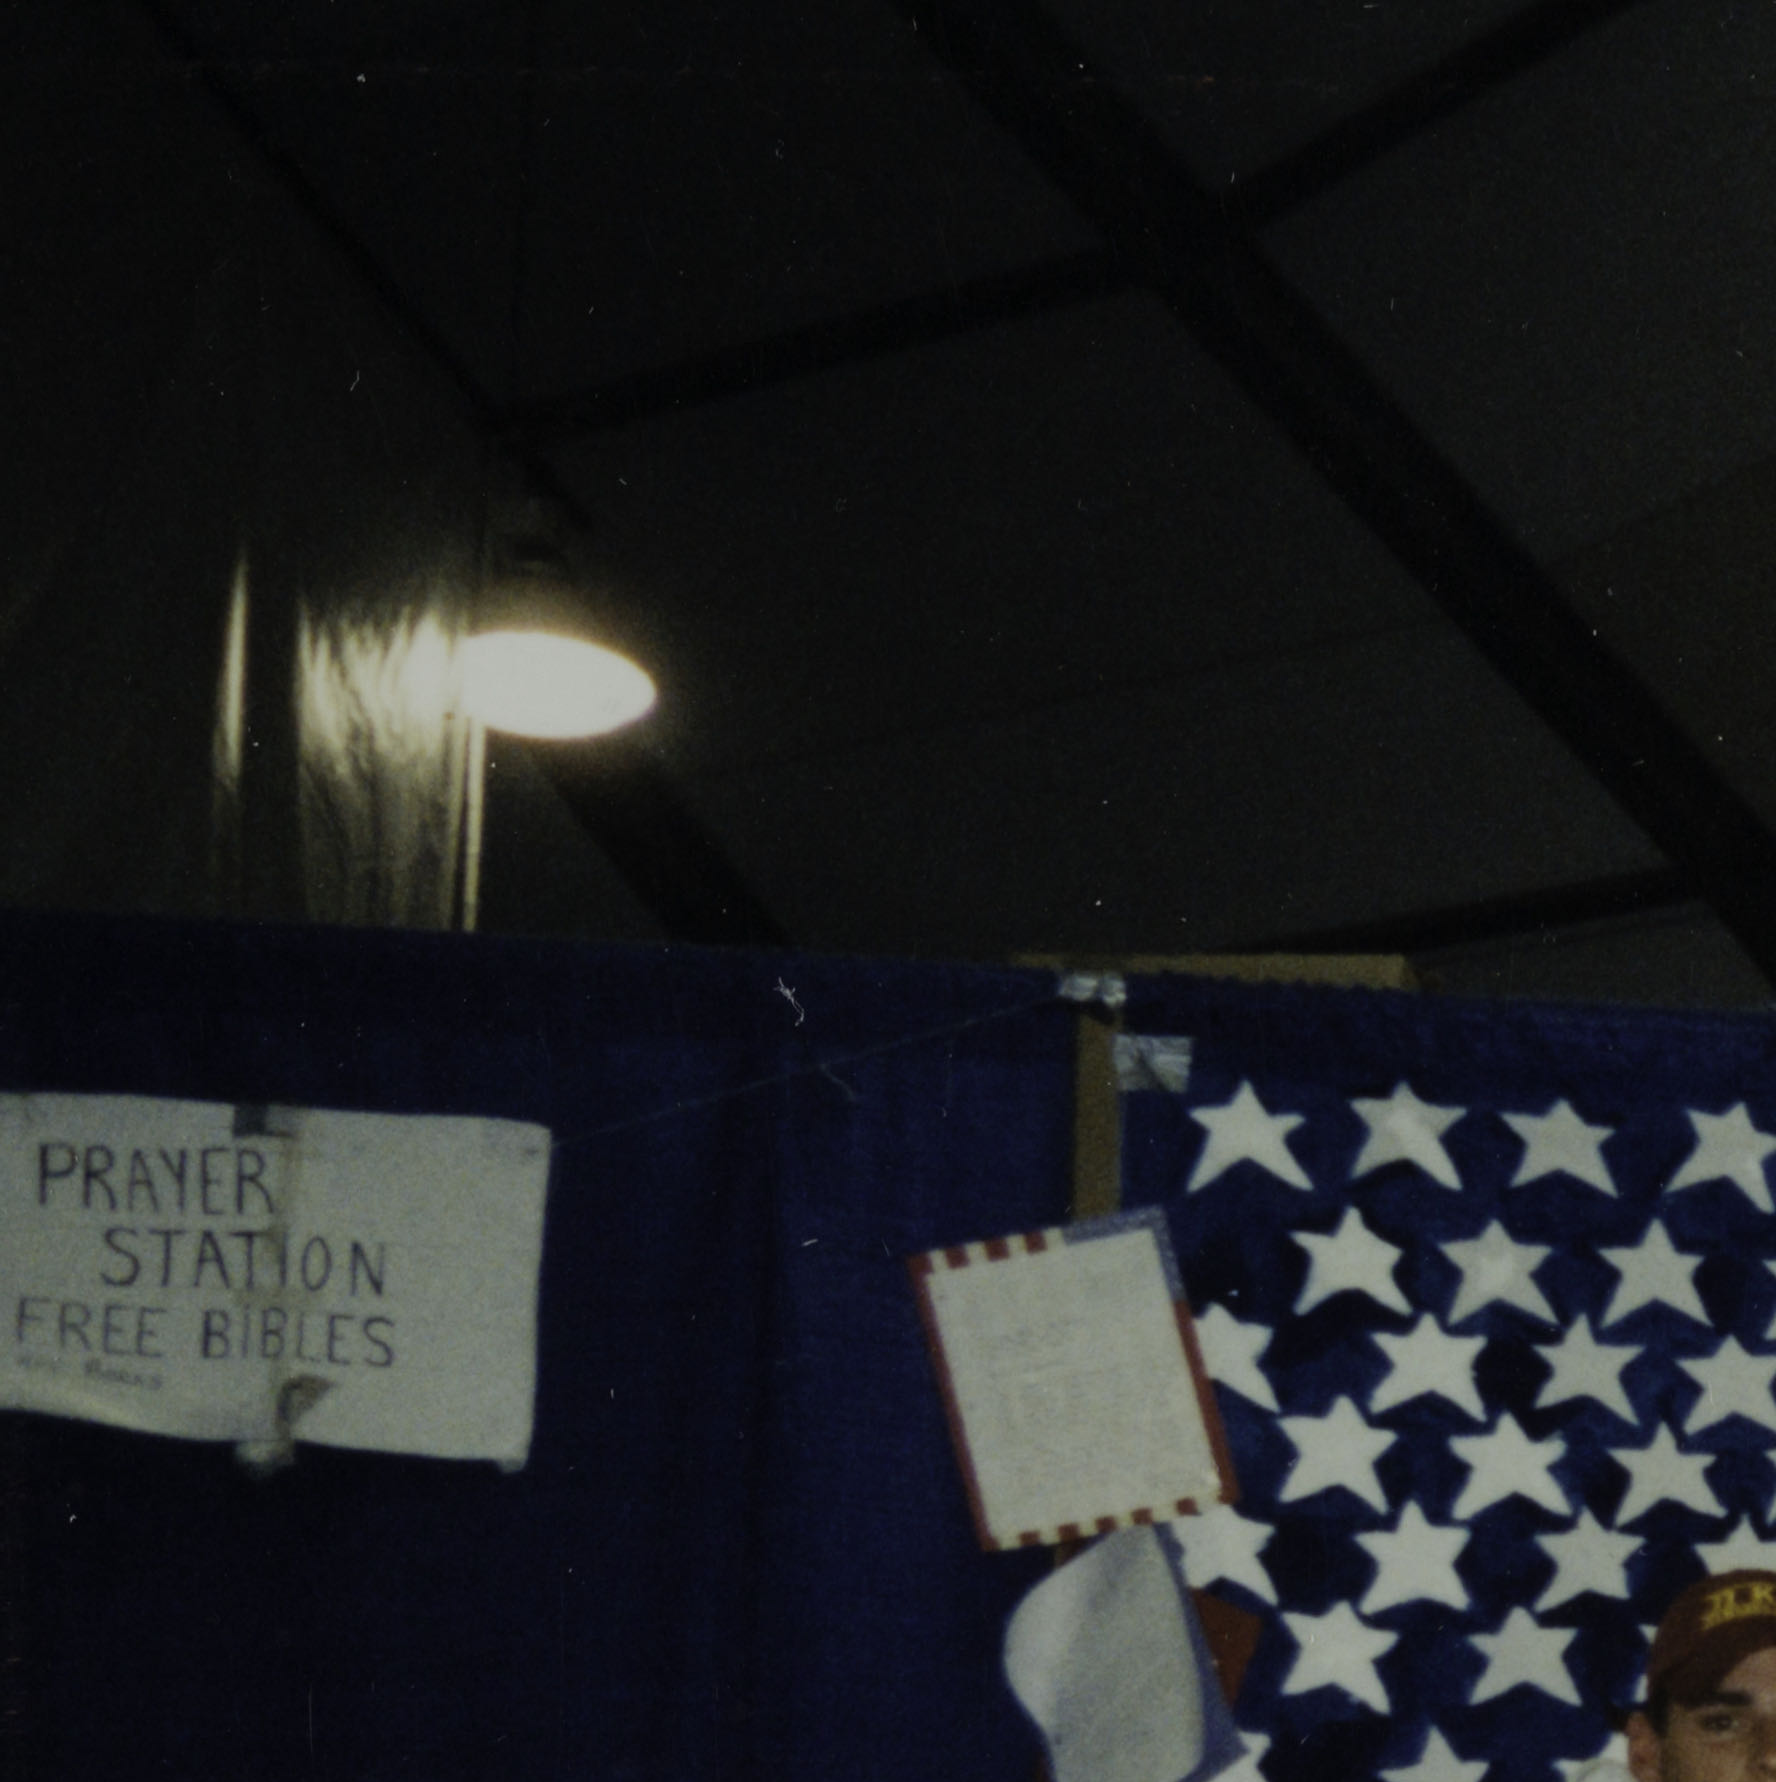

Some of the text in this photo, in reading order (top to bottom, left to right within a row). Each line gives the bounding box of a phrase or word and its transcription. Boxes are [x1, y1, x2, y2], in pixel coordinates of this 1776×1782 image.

[37, 1142, 275, 1216] PRAYER
[100, 1228, 389, 1297] STATION
[16, 1296, 167, 1358] FREE
